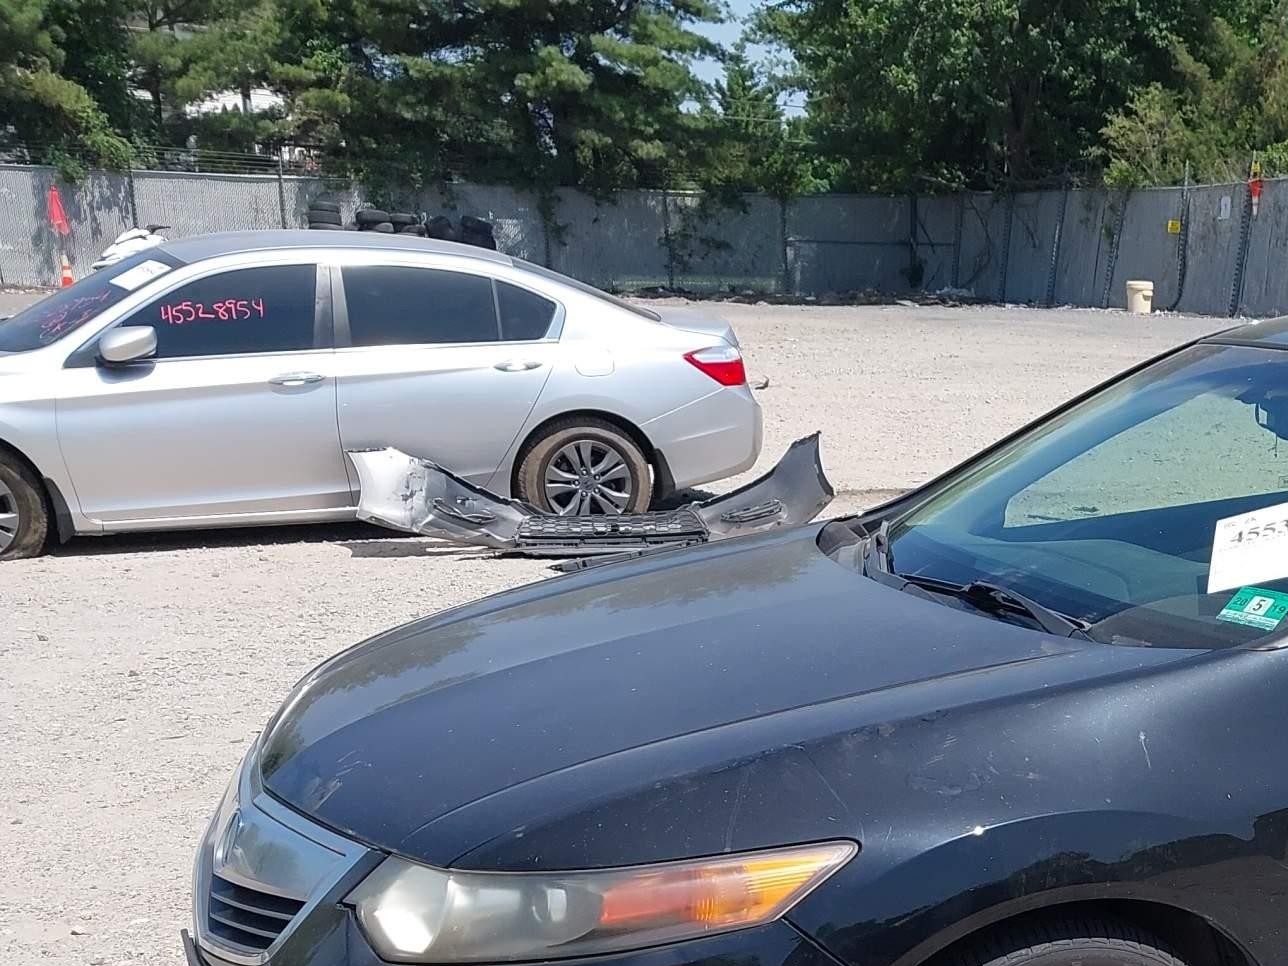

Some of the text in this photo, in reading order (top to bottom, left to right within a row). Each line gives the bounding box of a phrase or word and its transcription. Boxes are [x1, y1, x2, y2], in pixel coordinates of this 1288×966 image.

[160, 298, 264, 324] 45528954
[1252, 599, 1267, 612] 5
[1271, 603, 1287, 615] 19
